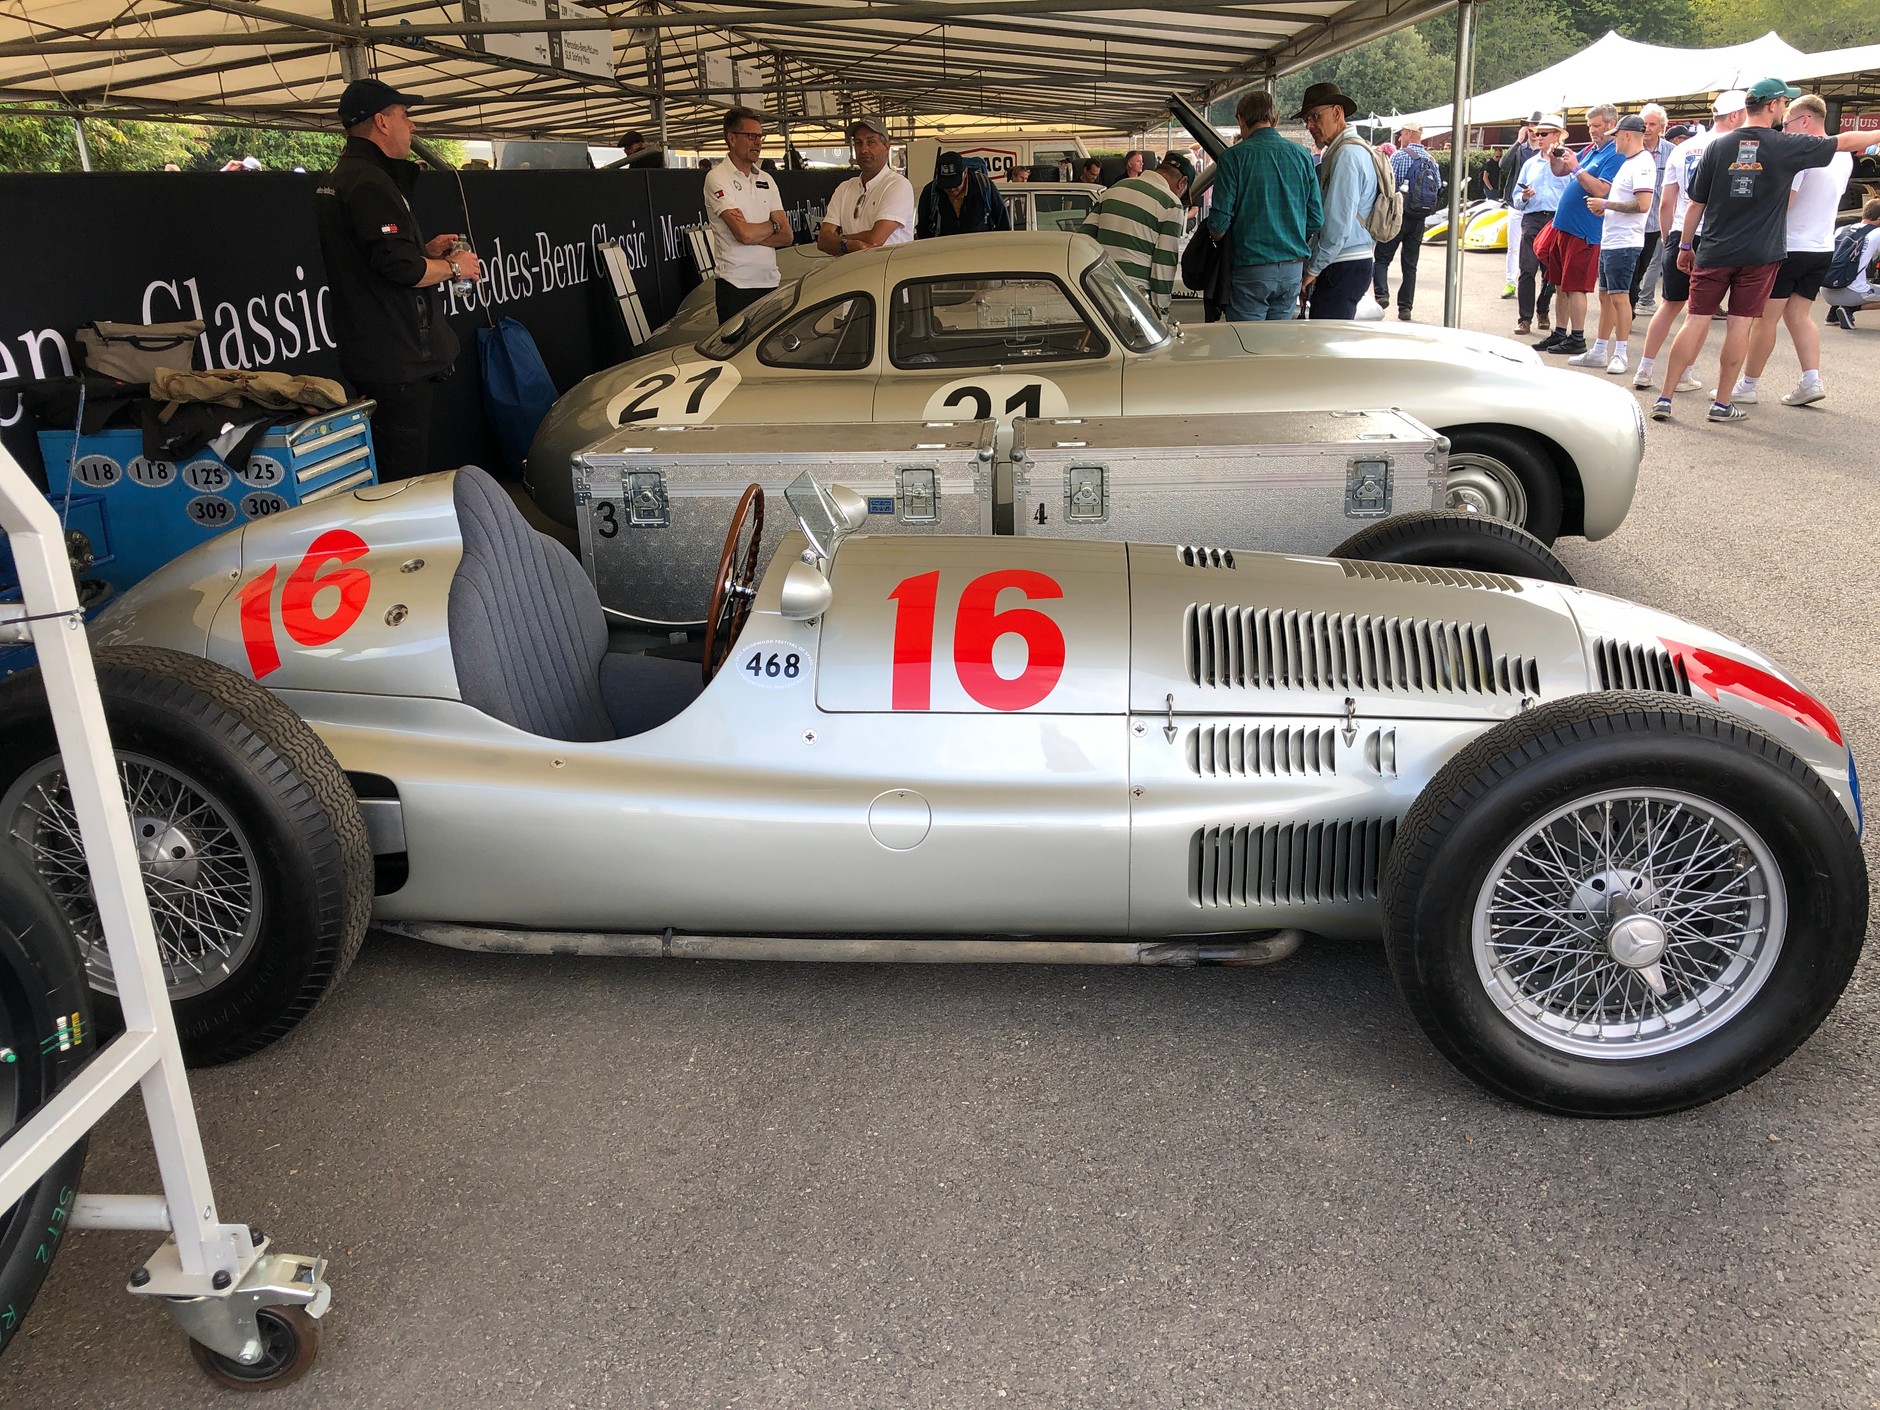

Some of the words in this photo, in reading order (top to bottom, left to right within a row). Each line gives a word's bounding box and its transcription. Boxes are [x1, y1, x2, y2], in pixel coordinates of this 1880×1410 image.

[983, 156, 1014, 172] ACO
[617, 365, 725, 426] 21
[81, 464, 115, 482] 118
[135, 461, 169, 480] 118
[191, 467, 225, 486] 125
[244, 463, 276, 481] 125
[194, 502, 228, 520] 309
[249, 498, 282, 516] 309
[1033, 502, 1048, 525] 4
[596, 501, 619, 538] 3
[234, 528, 373, 681] 16
[886, 568, 1067, 712] 16
[745, 651, 801, 679] 468
